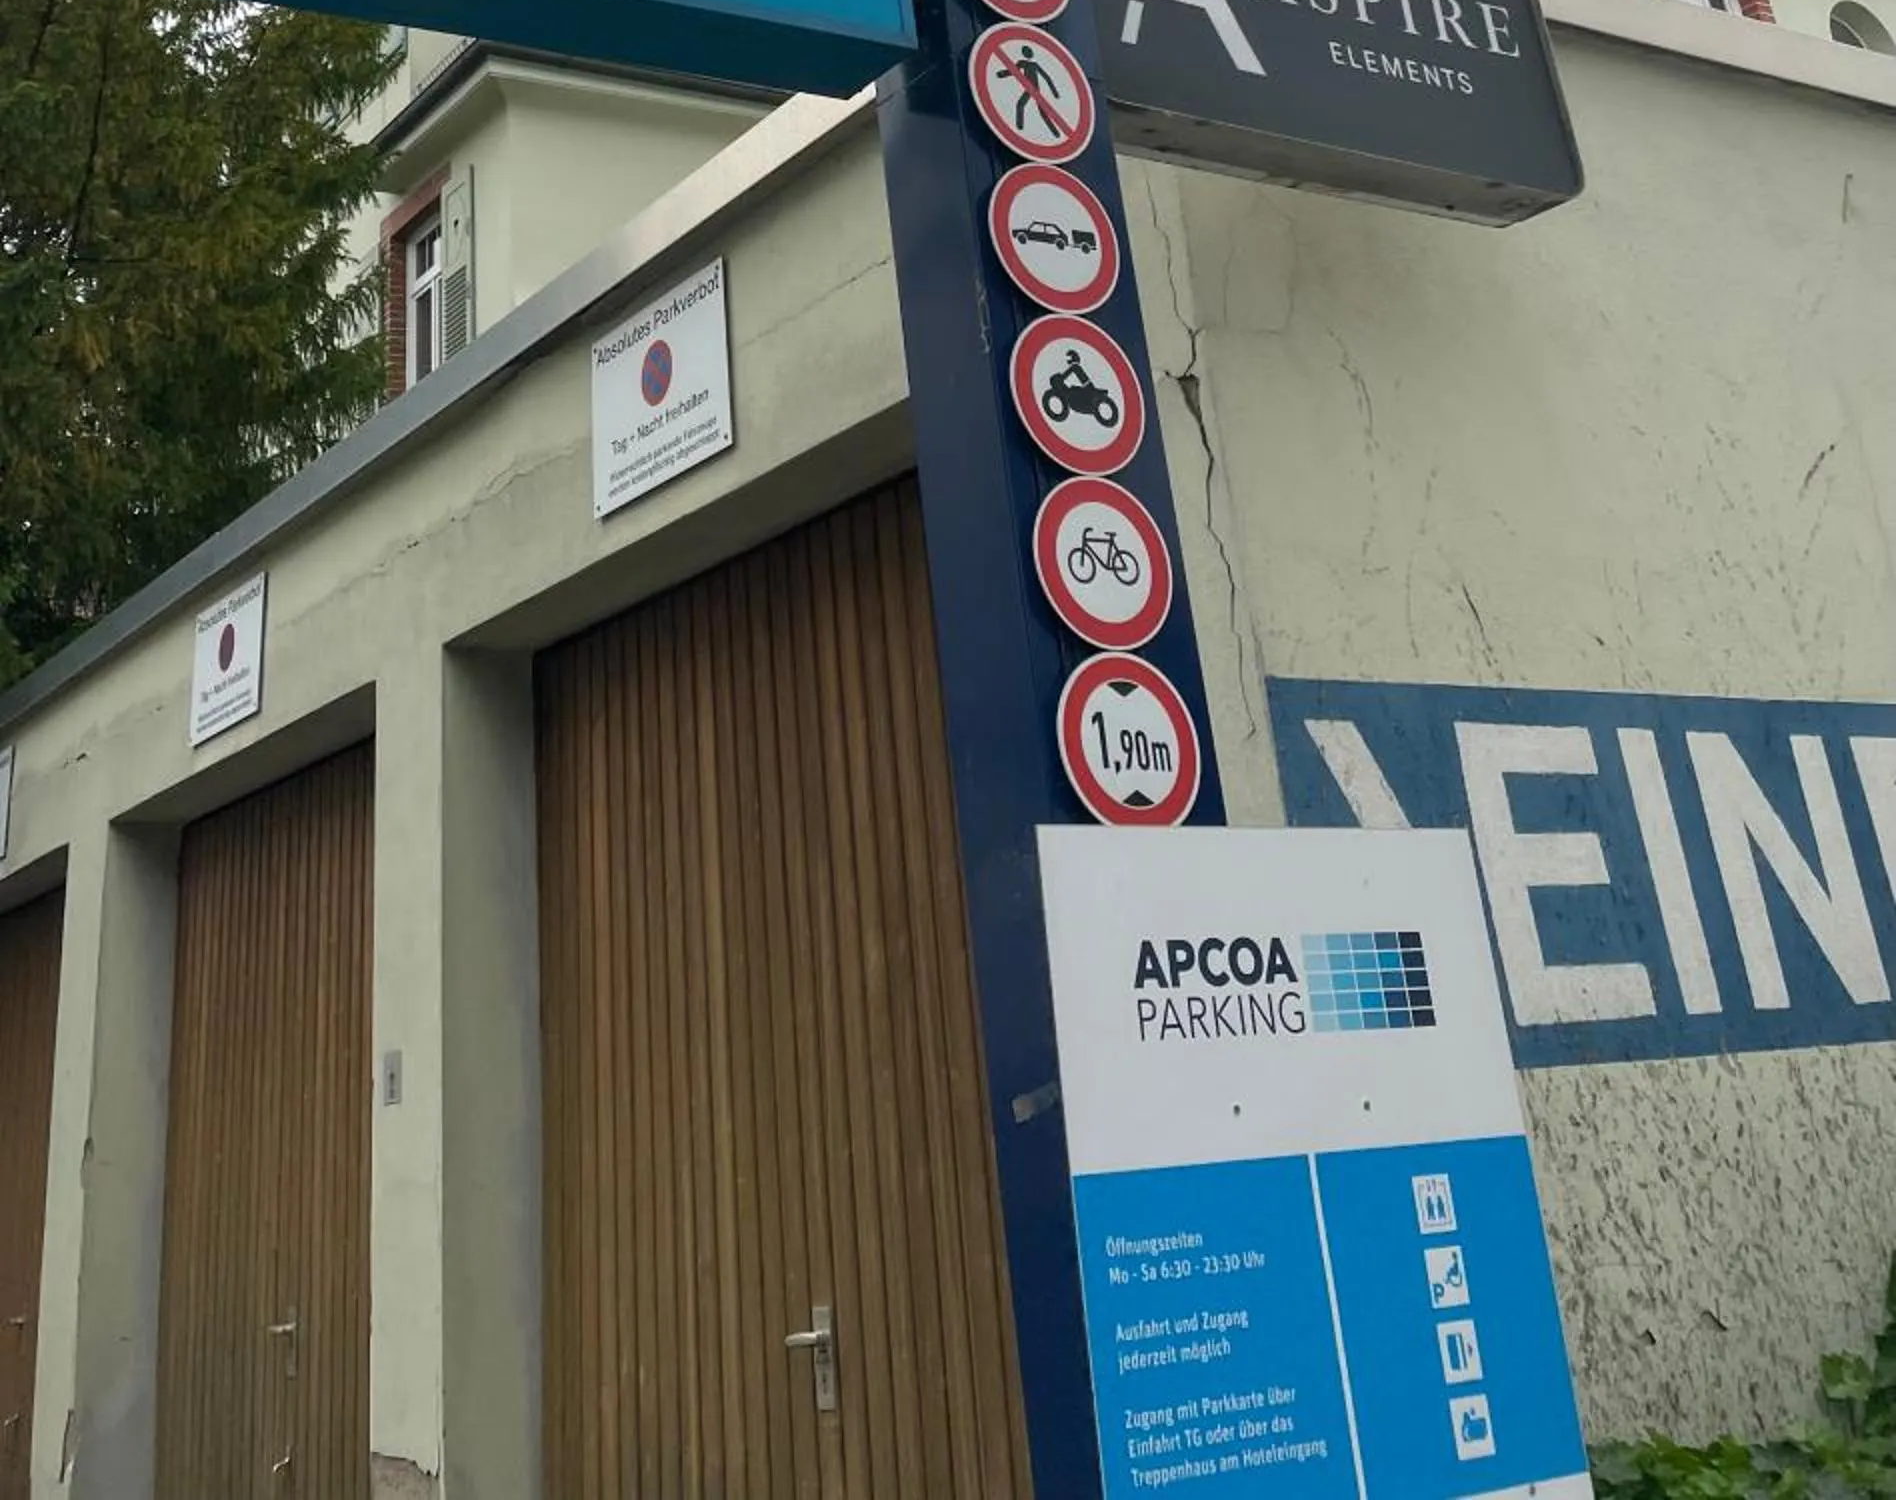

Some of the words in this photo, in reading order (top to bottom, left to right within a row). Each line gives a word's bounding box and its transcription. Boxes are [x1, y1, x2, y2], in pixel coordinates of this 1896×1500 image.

[1328, 40, 1475, 95] ELEMENTS
[597, 320, 651, 366] Absolutes
[653, 271, 720, 330] Parkverbot
[1091, 710, 1174, 776] 1,90m
[1133, 936, 1299, 989] APCOA
[1137, 990, 1307, 1042] PARKING
[1105, 1232, 1203, 1258] Öffnungszeiten
[1108, 1266, 1129, 1285] Mo
[1140, 1263, 1157, 1282] Sa
[1160, 1259, 1191, 1279] 6:30
[1203, 1256, 1241, 1274] 23:30
[1242, 1251, 1265, 1269] Uhr
[1115, 1319, 1172, 1342] Ausfahrt
[1175, 1312, 1198, 1333] und
[1201, 1309, 1249, 1334] Zugang
[1118, 1347, 1177, 1376] jederzeit
[1180, 1337, 1231, 1364] möglich
[1124, 1406, 1175, 1431] Zugang
[1177, 1400, 1198, 1419] mit
[1201, 1391, 1265, 1416] Parkkarte
[1267, 1384, 1296, 1404] über
[1127, 1434, 1182, 1458] Einfahrt
[1184, 1428, 1203, 1448] TG
[1205, 1423, 1234, 1444] oder
[1238, 1419, 1268, 1439] über
[1271, 1414, 1294, 1432] das
[1131, 1457, 1217, 1489] Treppenhaus
[1219, 1453, 1239, 1470] am
[1242, 1438, 1328, 1468] Hoteleingang
